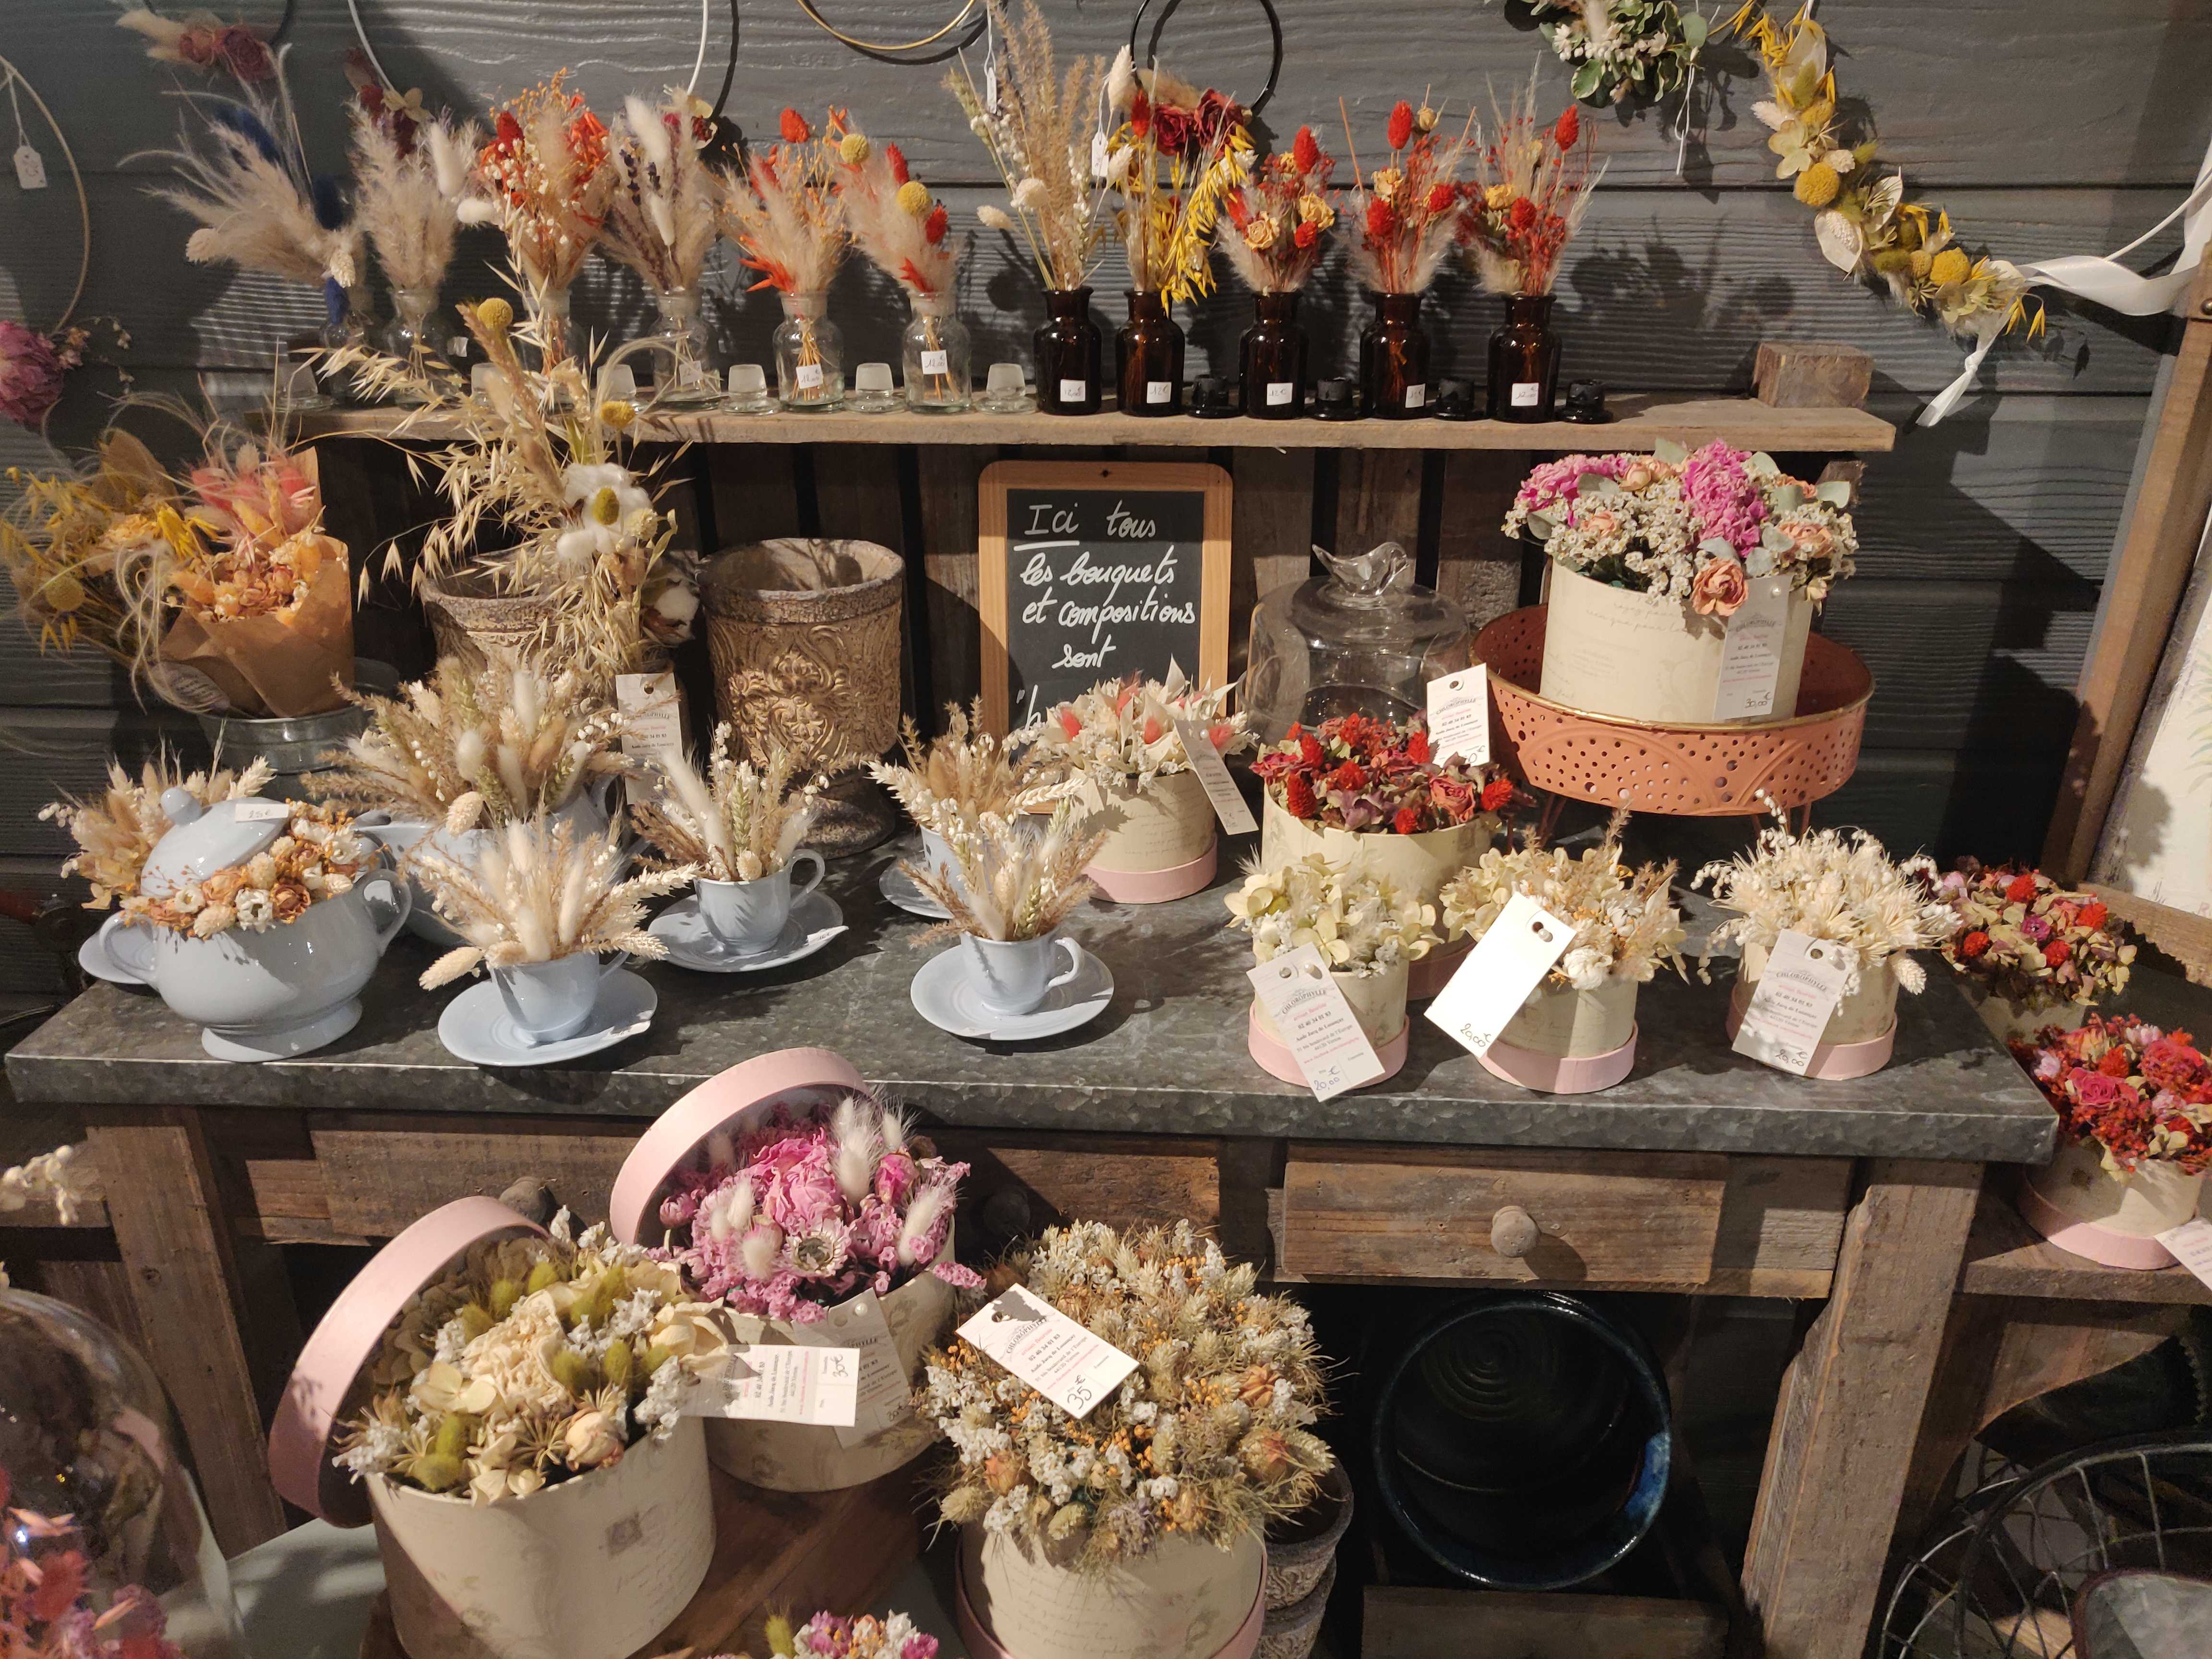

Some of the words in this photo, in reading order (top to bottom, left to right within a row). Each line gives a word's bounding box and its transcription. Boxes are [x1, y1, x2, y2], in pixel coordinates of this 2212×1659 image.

[1025, 503, 1079, 535] Ici
[1106, 500, 1156, 538] tous
[1020, 553, 1053, 586] les
[1059, 545, 1178, 605] bouquets
[1022, 587, 1057, 624] et
[1058, 593, 1196, 644] compositions
[1776, 972, 1827, 991] CHLOROPHYLLE
[1282, 989, 1326, 1014] CHLOROPHYLLE
[1314, 1077, 1340, 1091] 20,00
[1328, 1066, 1340, 1075] €
[1006, 1317, 1047, 1354] CHLOROPHYLLE
[1075, 1374, 1085, 1385] €
[1067, 1386, 1092, 1409] 35
